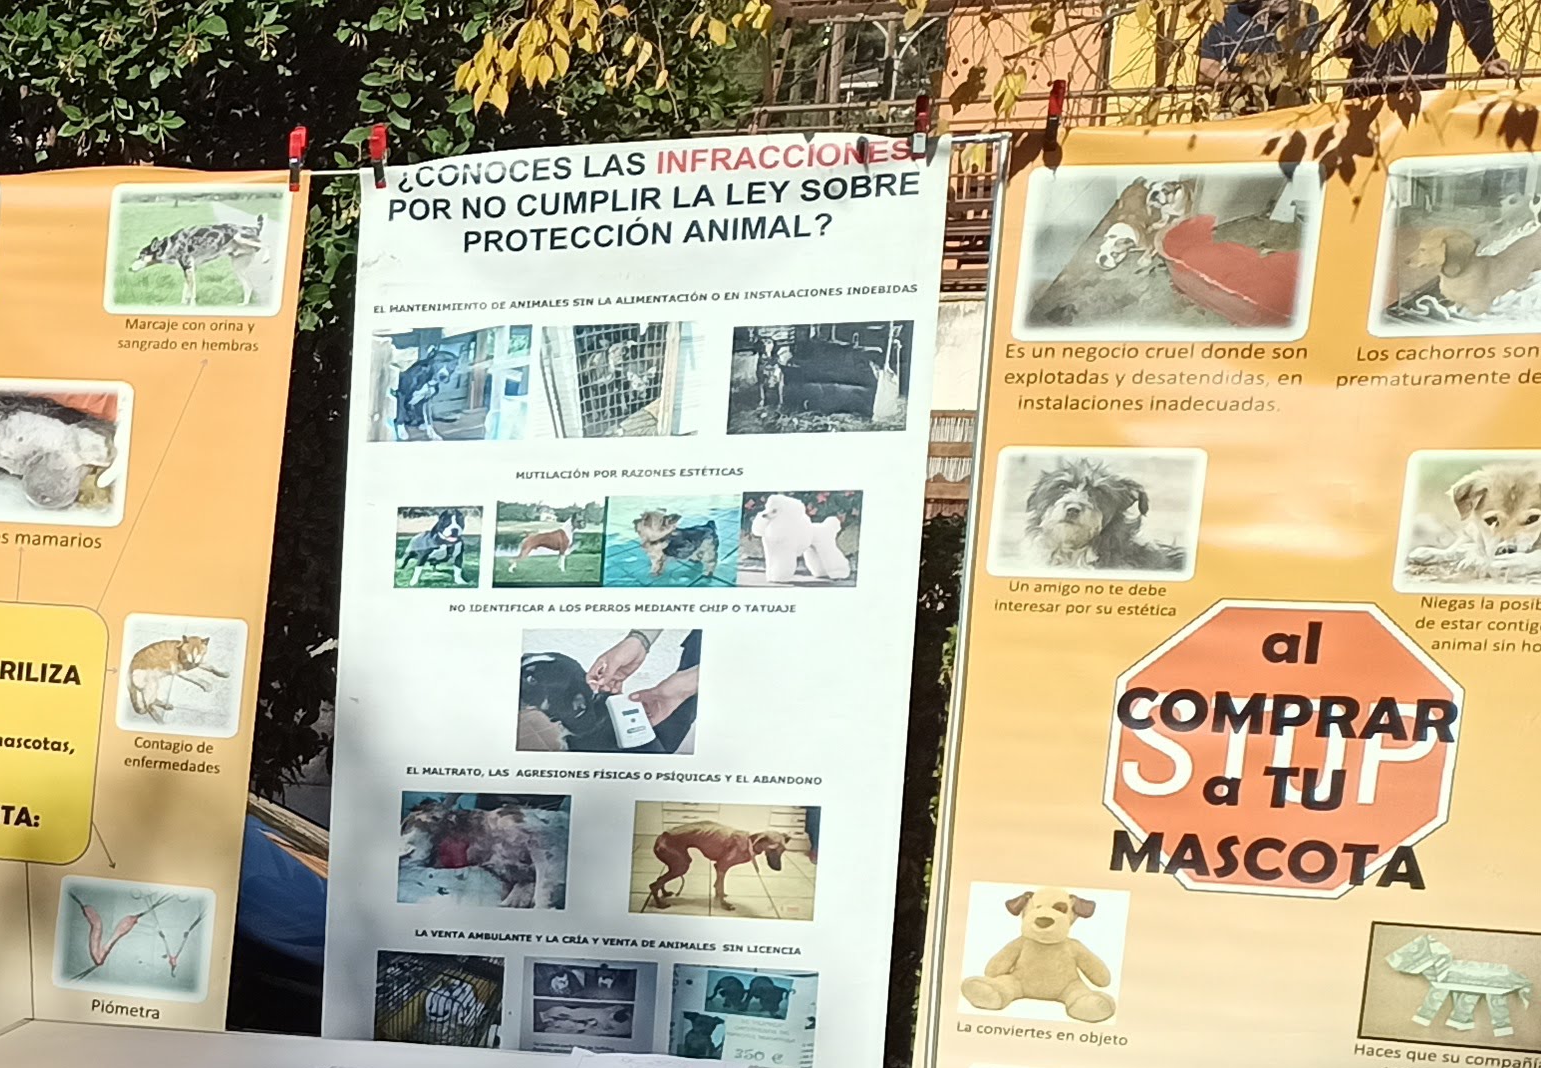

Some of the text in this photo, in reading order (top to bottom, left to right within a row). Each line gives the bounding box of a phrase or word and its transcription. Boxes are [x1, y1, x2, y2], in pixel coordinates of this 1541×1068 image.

[396, 139, 912, 194] ¿CONOCES LAS INFRACCIONES
[387, 170, 920, 222] POR NO CUMPLIR LA LEY SOBRE
[463, 211, 833, 254] PROTECCIÓN ANIMAL?
[372, 282, 918, 314] EL MANTENIMIENTO DE ANIMALES SIN LA ALIMENTACIÓN O EN INSTALACIONES INDEBIDAS
[124, 317, 256, 335] Marcaje con orina y
[116, 336, 259, 353] sangrado en hembras
[1004, 342, 1308, 363] Es un negocio cruel donde son
[1355, 343, 1540, 362] Los cachorros son
[1003, 367, 1303, 388] explotadas y desatendidas, en
[1334, 368, 1511, 389] prematuramente
[1017, 393, 1281, 412] instalaciones inadecuadas.
[514, 465, 744, 480] MUTILACIÓN POR RAZONES ESTÉTICAS
[13, 531, 102, 550] mamarios
[1008, 579, 1167, 597] Un amigo no te debe
[993, 598, 1177, 617] interesar por su estética
[1419, 595, 1495, 613] Niegas la
[1413, 615, 1483, 631] de estar
[1260, 619, 1324, 665] al
[1430, 637, 1516, 652] animal sin
[1115, 685, 1459, 744] COMPRAR
[133, 735, 214, 755] Contagio de
[122, 754, 221, 775] enfermedades
[1202, 765, 1349, 815] a TU
[1107, 828, 1427, 891] MASCOTA
[90, 997, 160, 1020] Piómetra
[955, 1020, 1129, 1047] La conviertes en objeto
[1353, 1042, 1402, 1059] Haces
[1405, 1049, 1438, 1063] que
[1440, 1052, 1460, 1064] su
